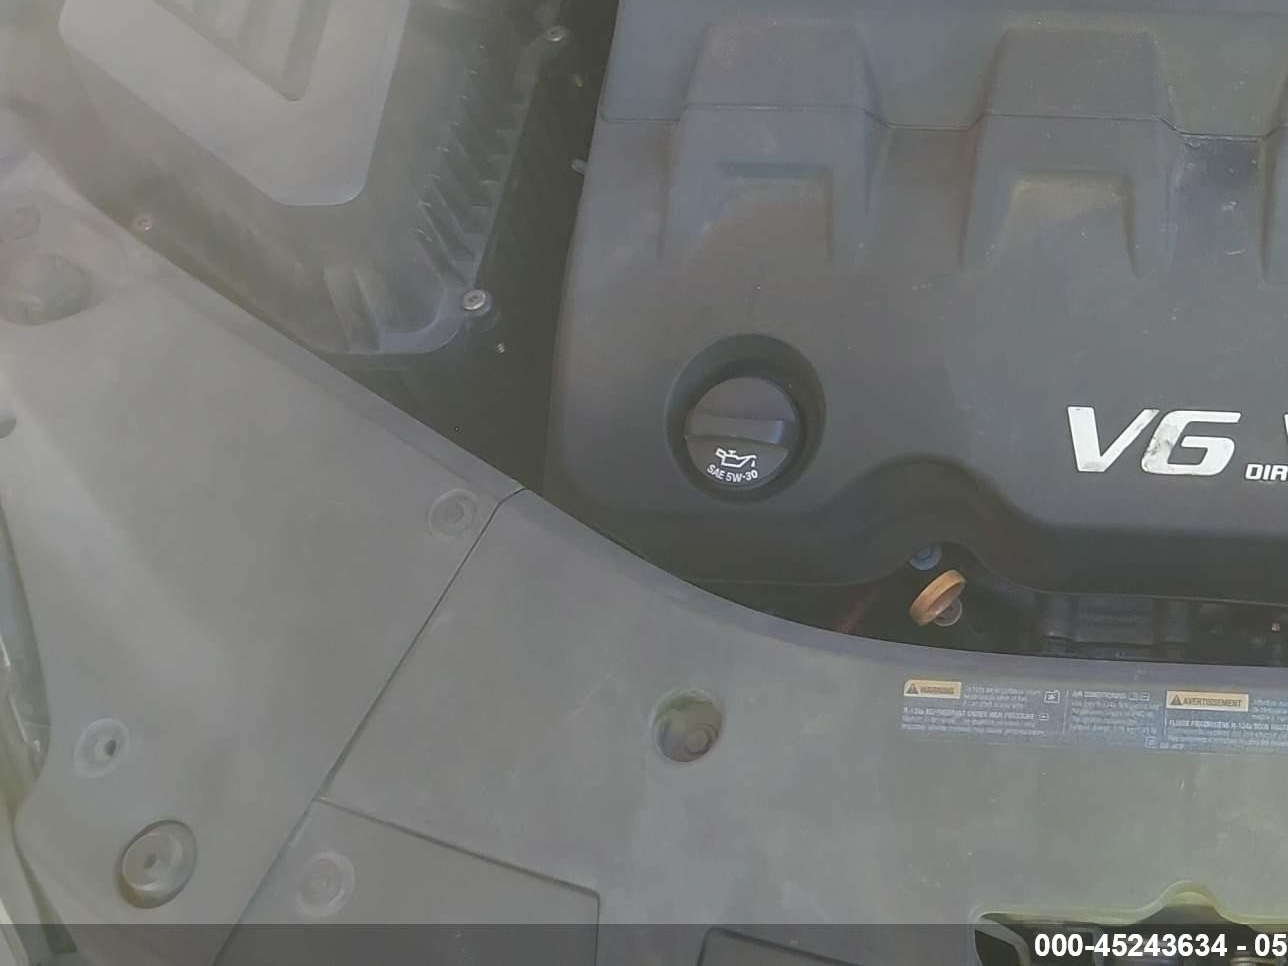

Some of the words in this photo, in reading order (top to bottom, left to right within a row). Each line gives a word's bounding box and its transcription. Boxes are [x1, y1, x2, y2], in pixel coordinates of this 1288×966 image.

[1067, 406, 1242, 475] V6
[706, 464, 726, 480] SAE
[725, 469, 758, 483] 5W-30
[1182, 697, 1243, 708] AVERTISSEMENT
